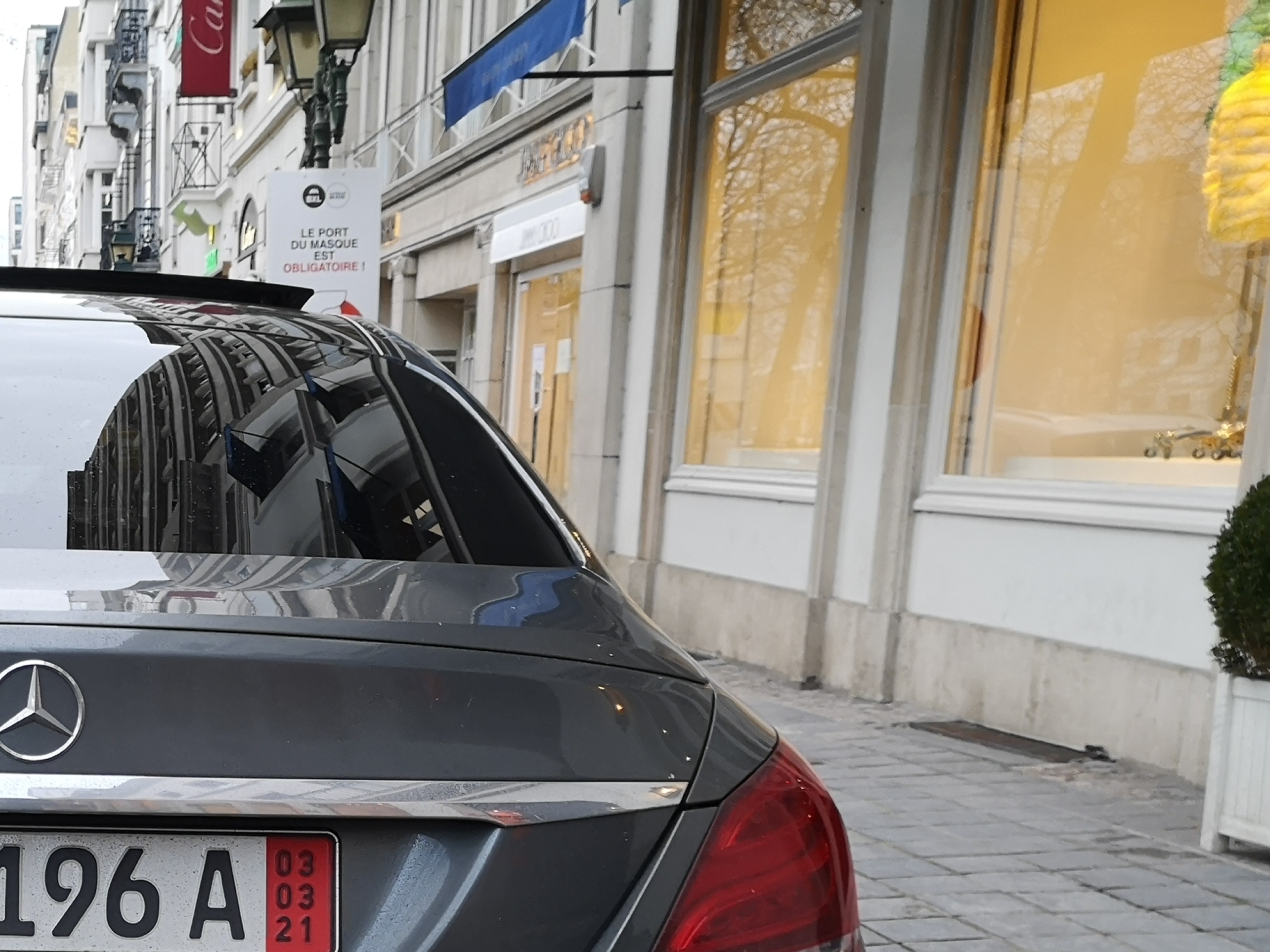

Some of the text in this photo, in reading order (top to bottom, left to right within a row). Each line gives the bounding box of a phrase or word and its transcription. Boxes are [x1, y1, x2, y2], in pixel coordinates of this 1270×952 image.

[301, 227, 349, 238] LE PORT
[291, 239, 359, 250] DU MASQUE
[314, 250, 335, 261] EST
[283, 262, 359, 273] OBLIGATOIRE
[275, 850, 314, 877] 03
[189, 849, 246, 940] A
[275, 883, 314, 910] 03
[275, 916, 311, 943] 21
